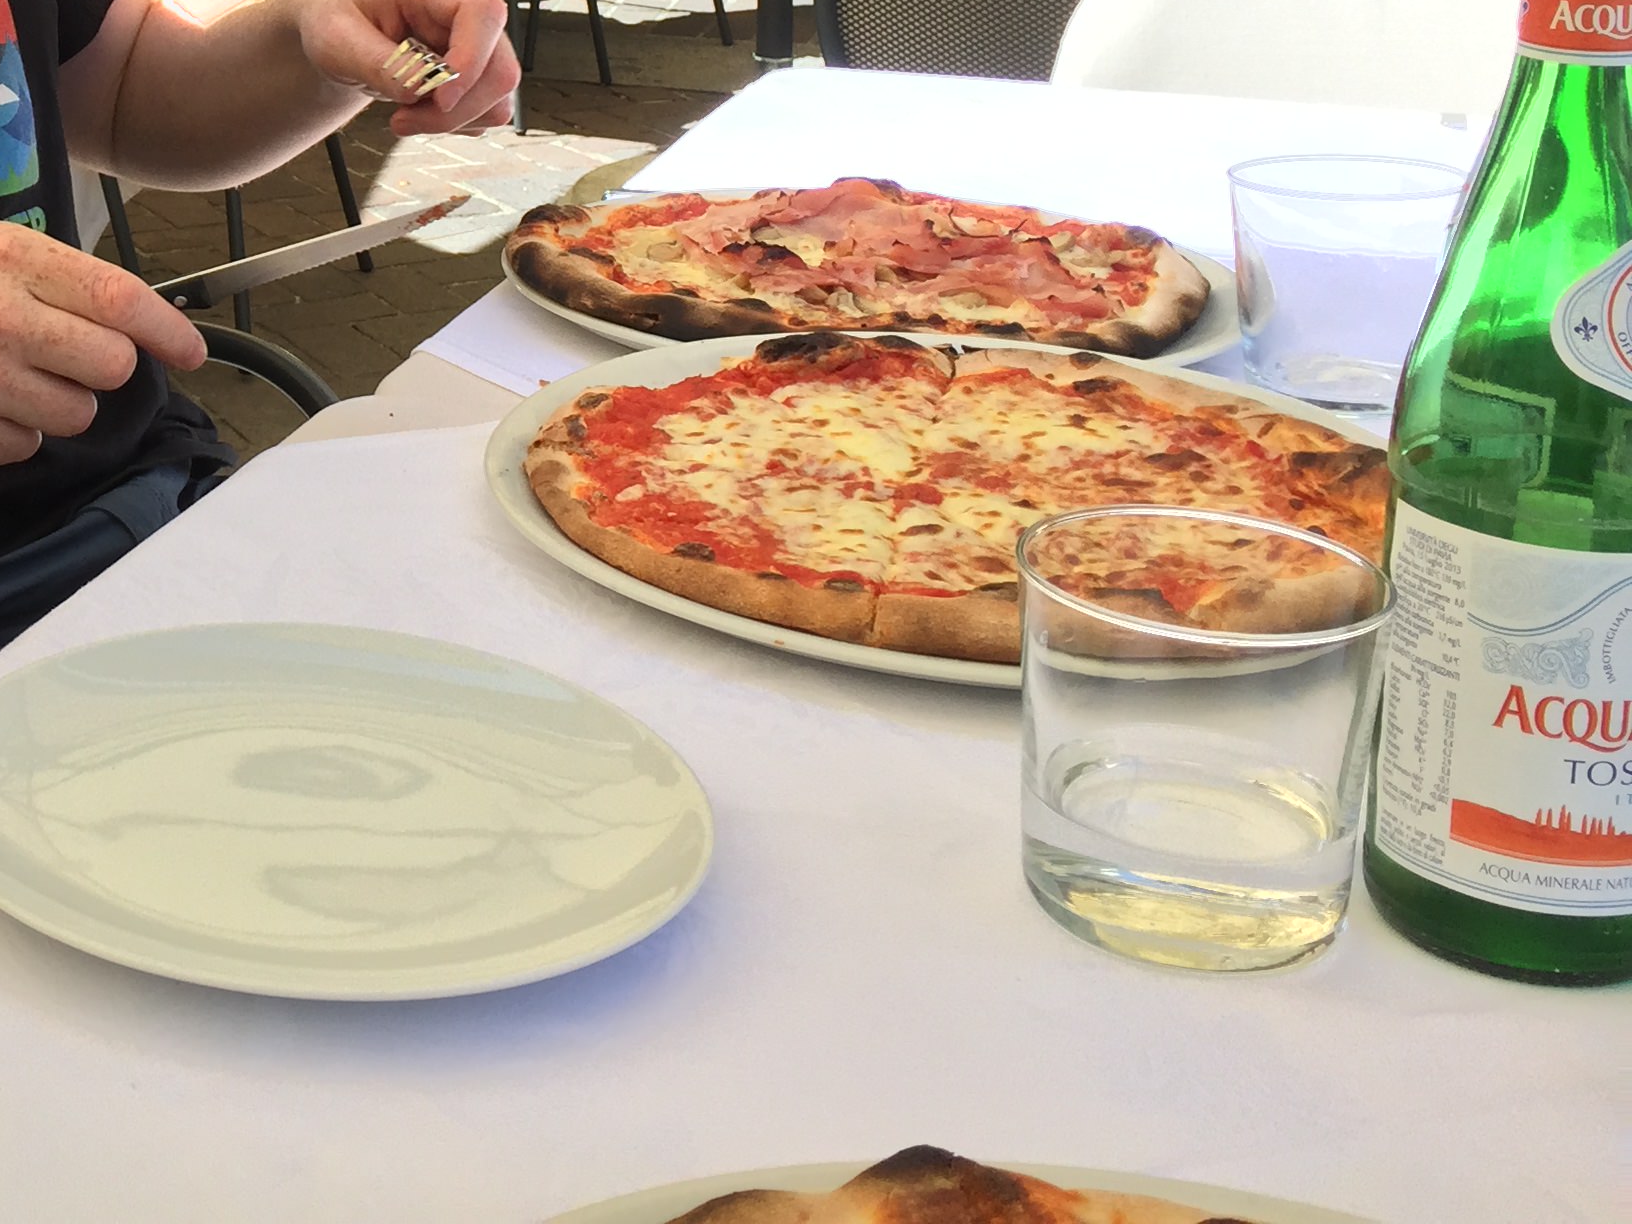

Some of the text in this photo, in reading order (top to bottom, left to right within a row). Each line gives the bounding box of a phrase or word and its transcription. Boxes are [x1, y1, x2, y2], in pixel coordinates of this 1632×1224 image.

[1491, 684, 1632, 753] ACQU
[1478, 862, 1531, 884] ACQUA
[1535, 874, 1603, 891] MINERALE
